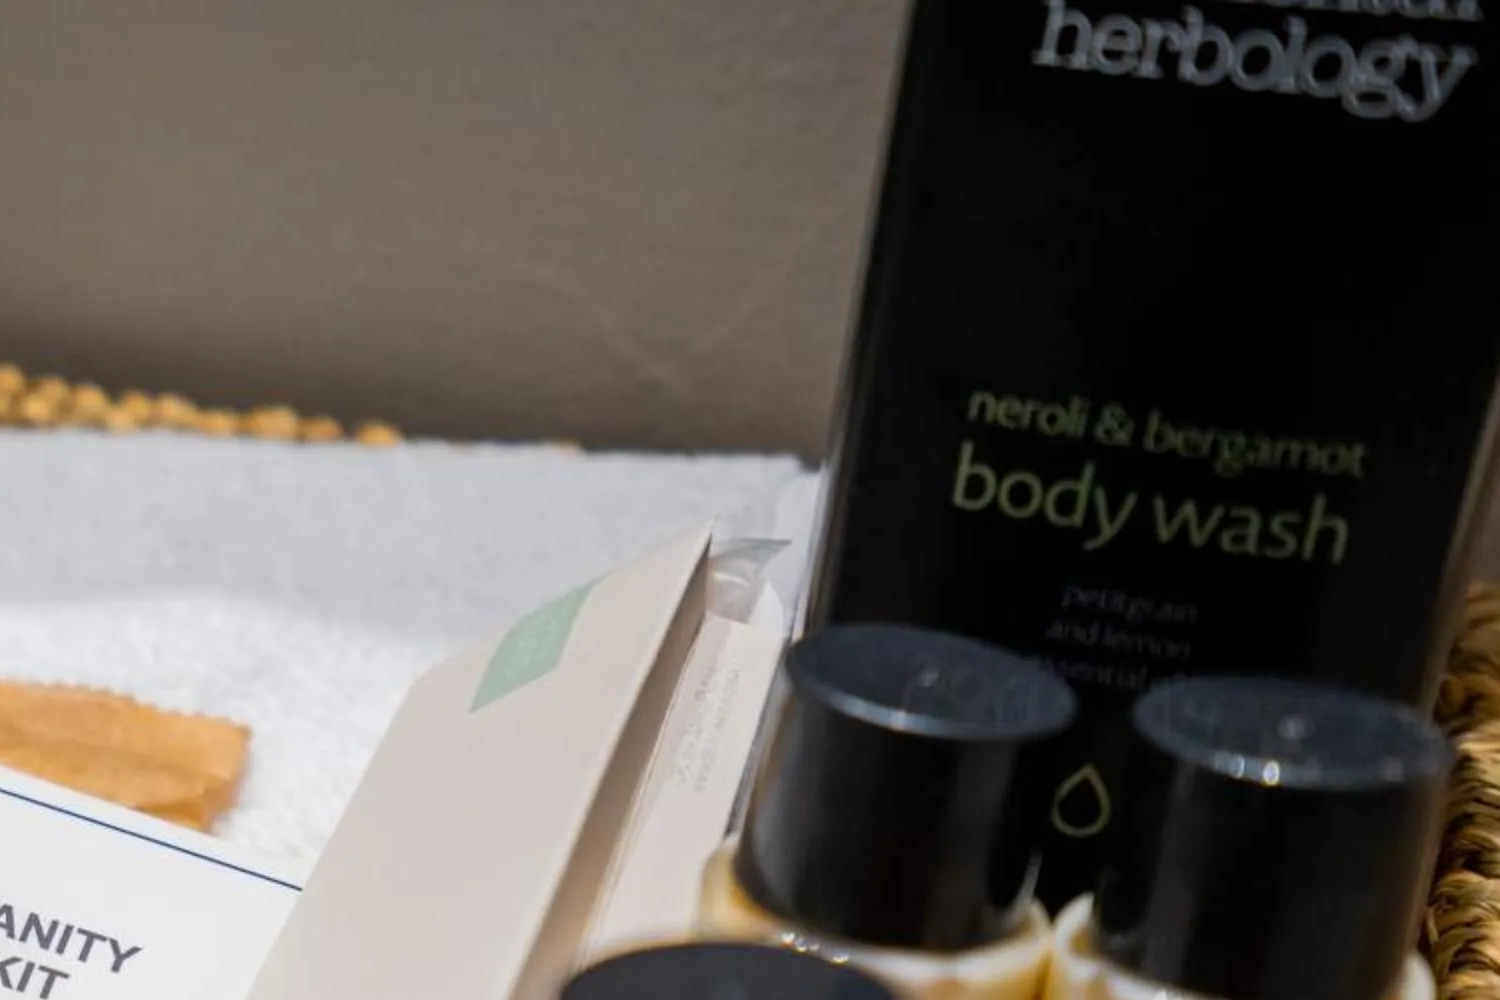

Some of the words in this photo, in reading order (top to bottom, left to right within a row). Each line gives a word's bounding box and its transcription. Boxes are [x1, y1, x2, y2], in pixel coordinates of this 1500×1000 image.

[1033, 0, 1478, 122] herbology
[967, 390, 1091, 440] neroli
[1094, 401, 1136, 447] &
[1143, 407, 1367, 479] bergamot
[952, 439, 1139, 552] body
[1152, 492, 1350, 567] wash
